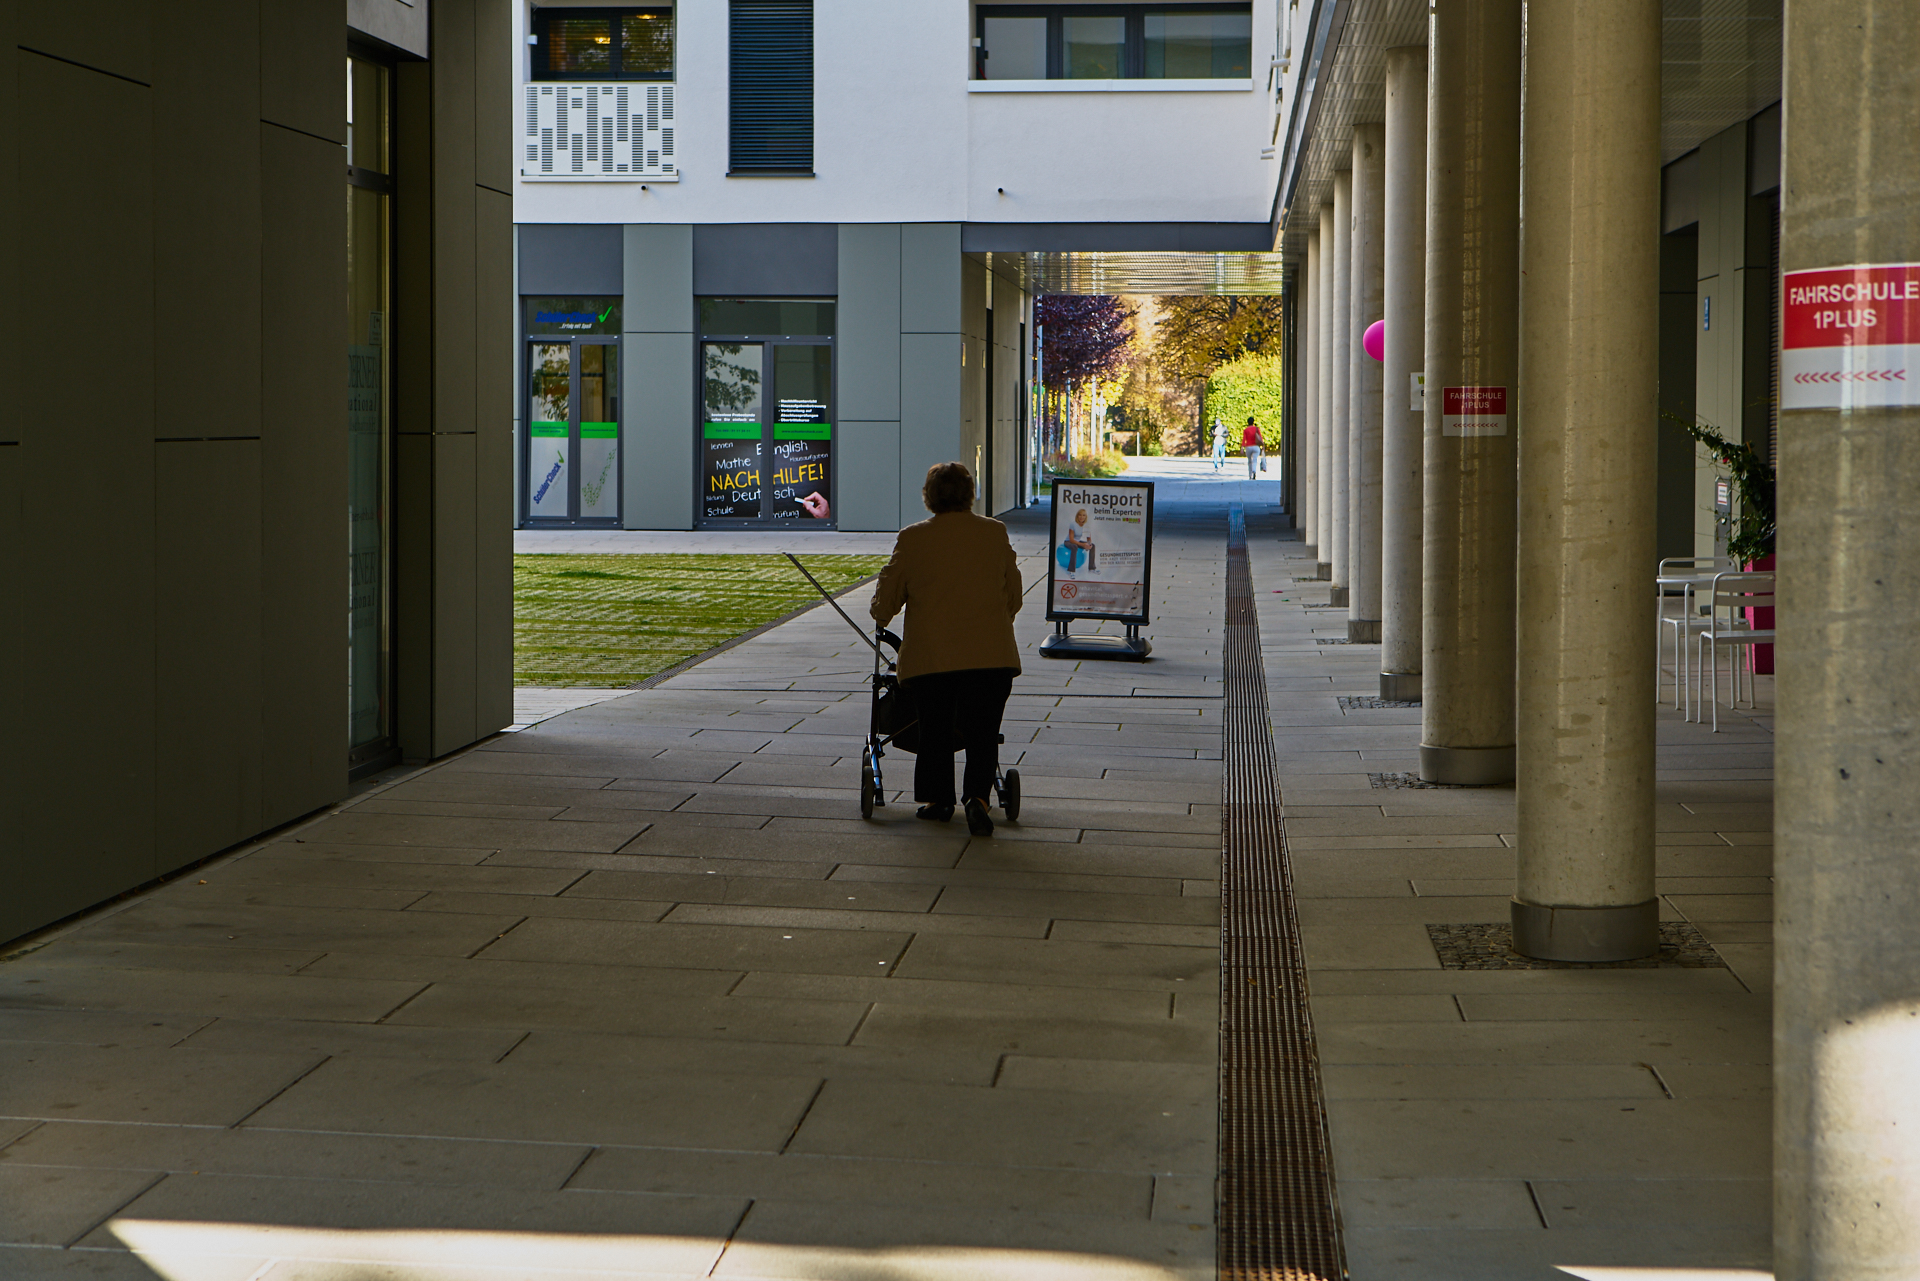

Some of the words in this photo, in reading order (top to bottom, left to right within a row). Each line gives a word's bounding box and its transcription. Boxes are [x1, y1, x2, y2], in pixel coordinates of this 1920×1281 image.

[1789, 280, 1919, 305] FAHRSCHULE
[1813, 308, 1878, 329] 1PLUS
[1449, 391, 1503, 400] FAHRSCHULE
[1463, 401, 1490, 409] 1PLUS
[710, 442, 734, 450] lernen
[715, 457, 752, 470] Mathe
[1062, 489, 1143, 508] Rehasport
[707, 505, 735, 517] Schule
[1112, 508, 1142, 517] Experten
